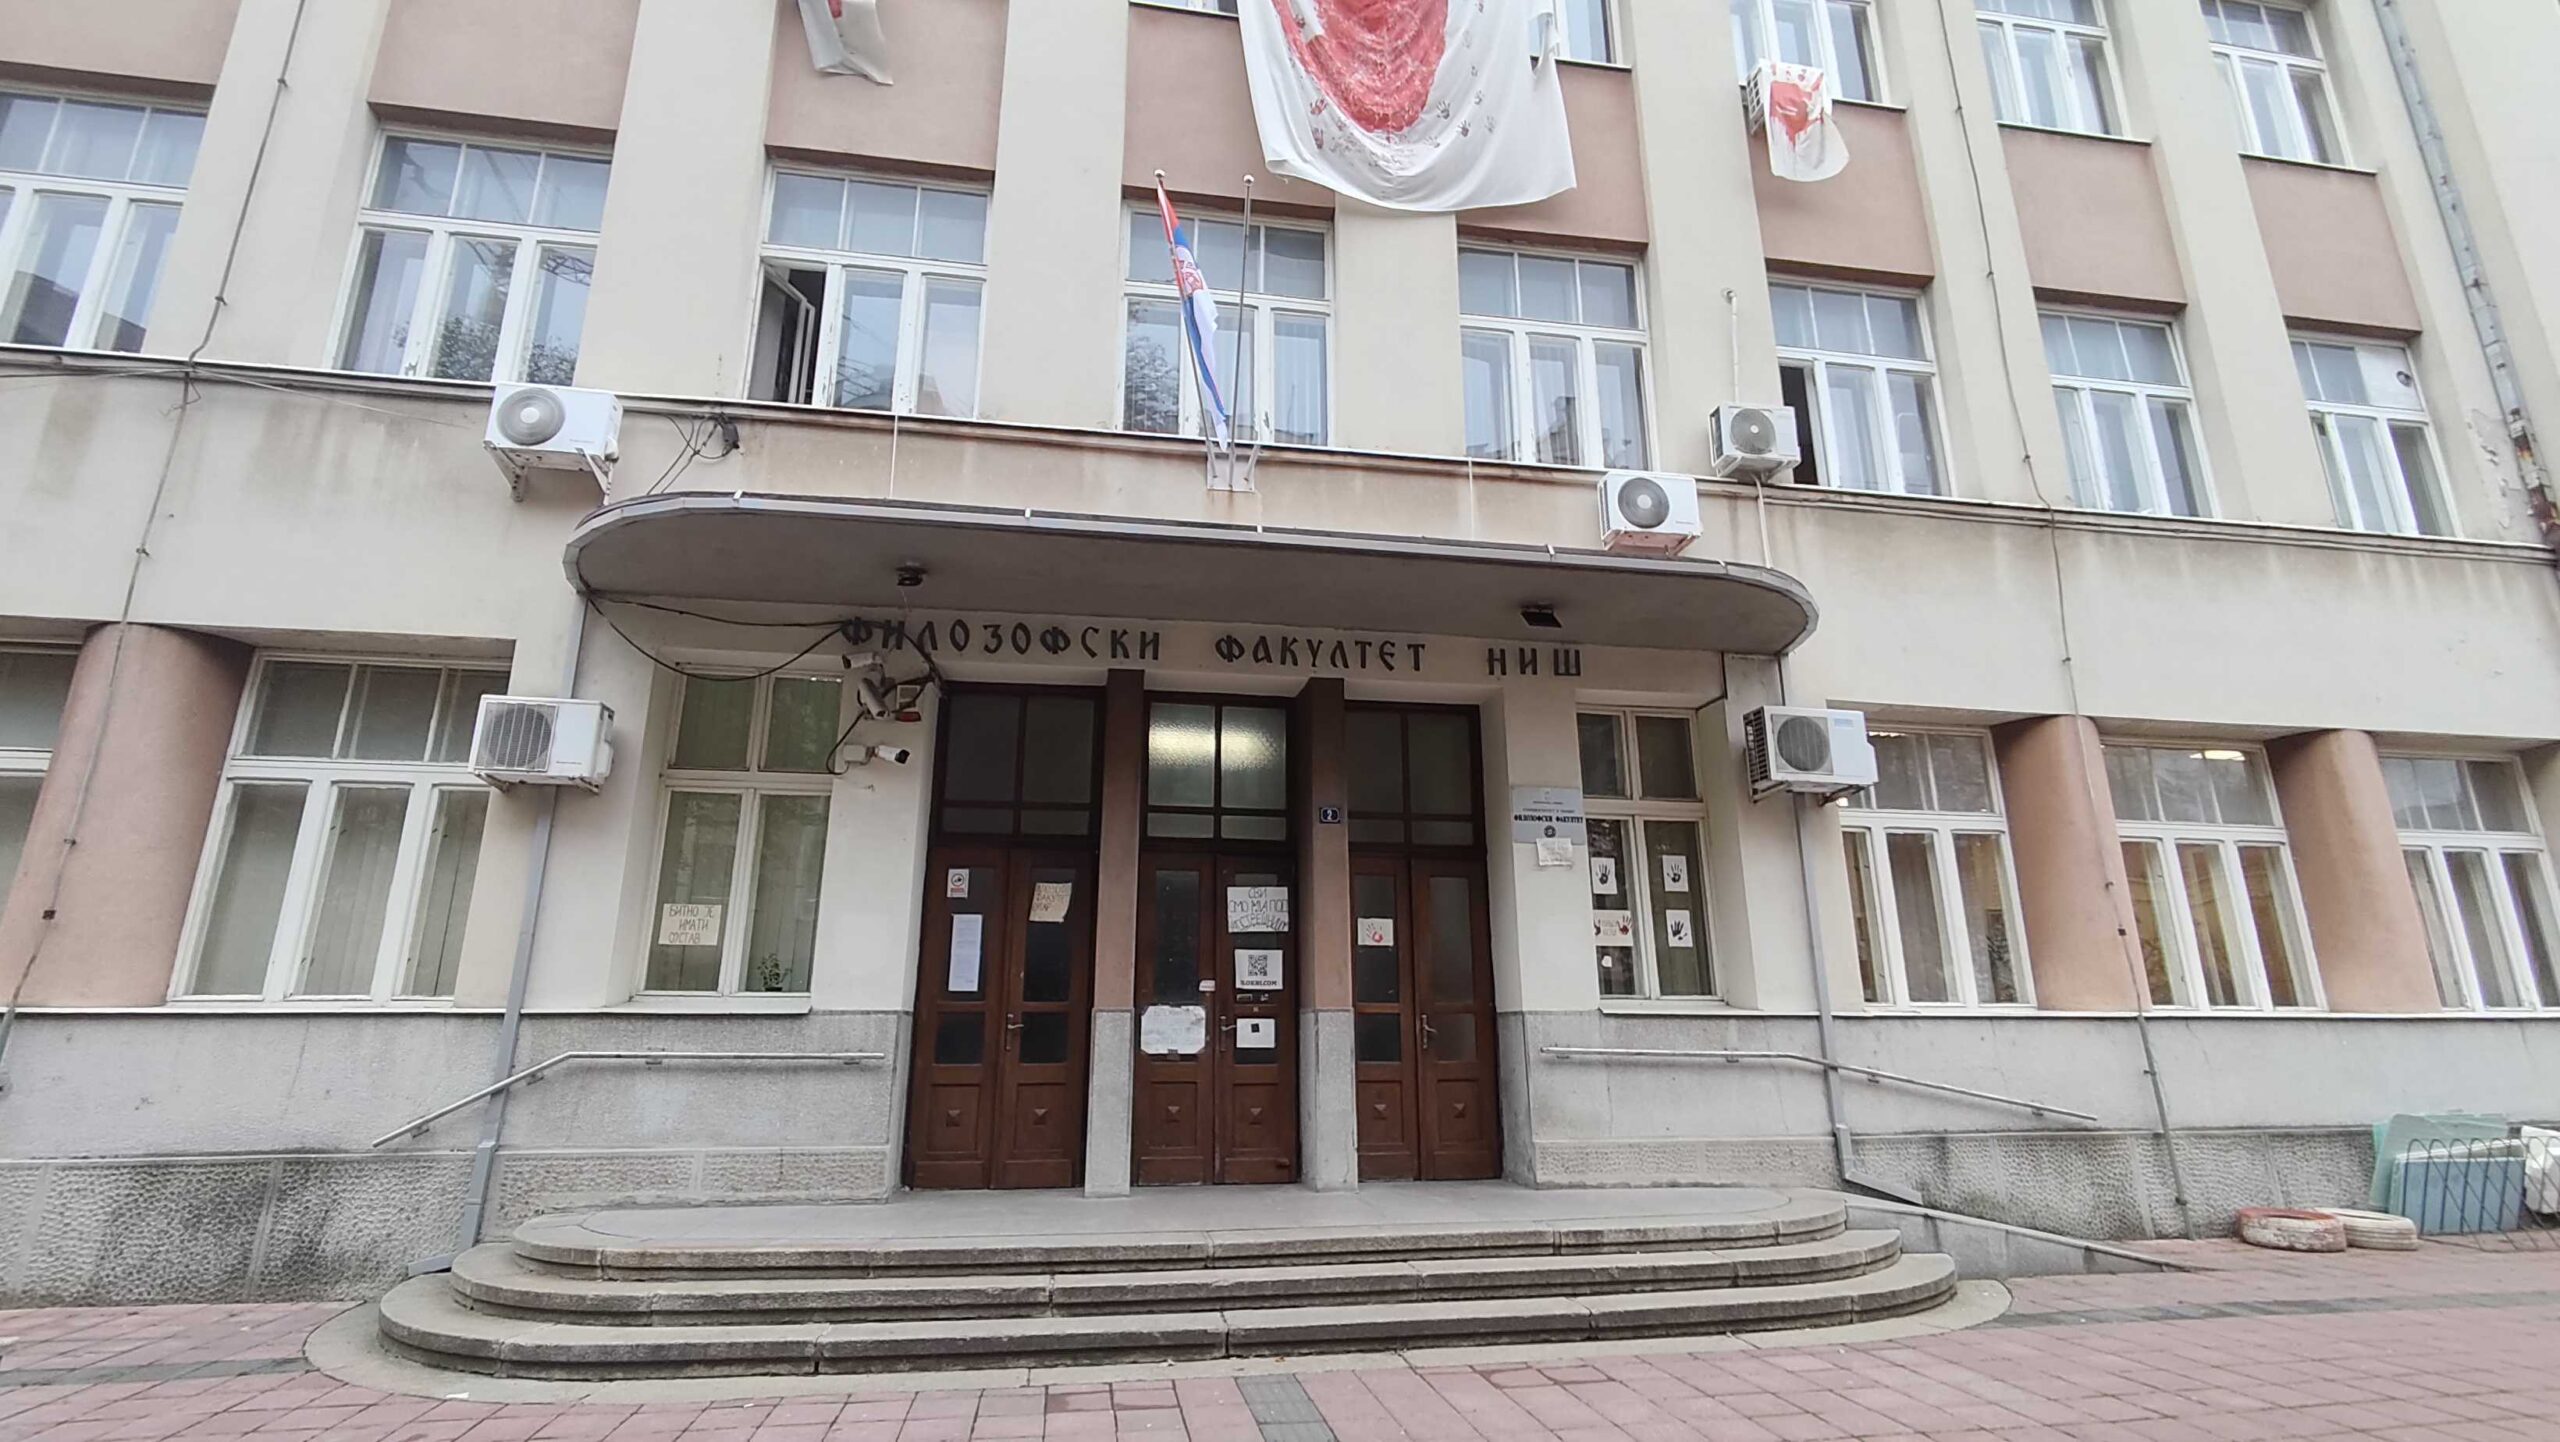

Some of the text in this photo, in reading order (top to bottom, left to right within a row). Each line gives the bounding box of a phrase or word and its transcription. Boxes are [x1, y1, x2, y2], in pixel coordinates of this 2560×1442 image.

[842, 616, 1581, 677] ФИЛОЗОФСКИ ФАКУЛТЕТ НИШ
[669, 905, 700, 917] БИТНО
[679, 919, 709, 931] ИМАТИ
